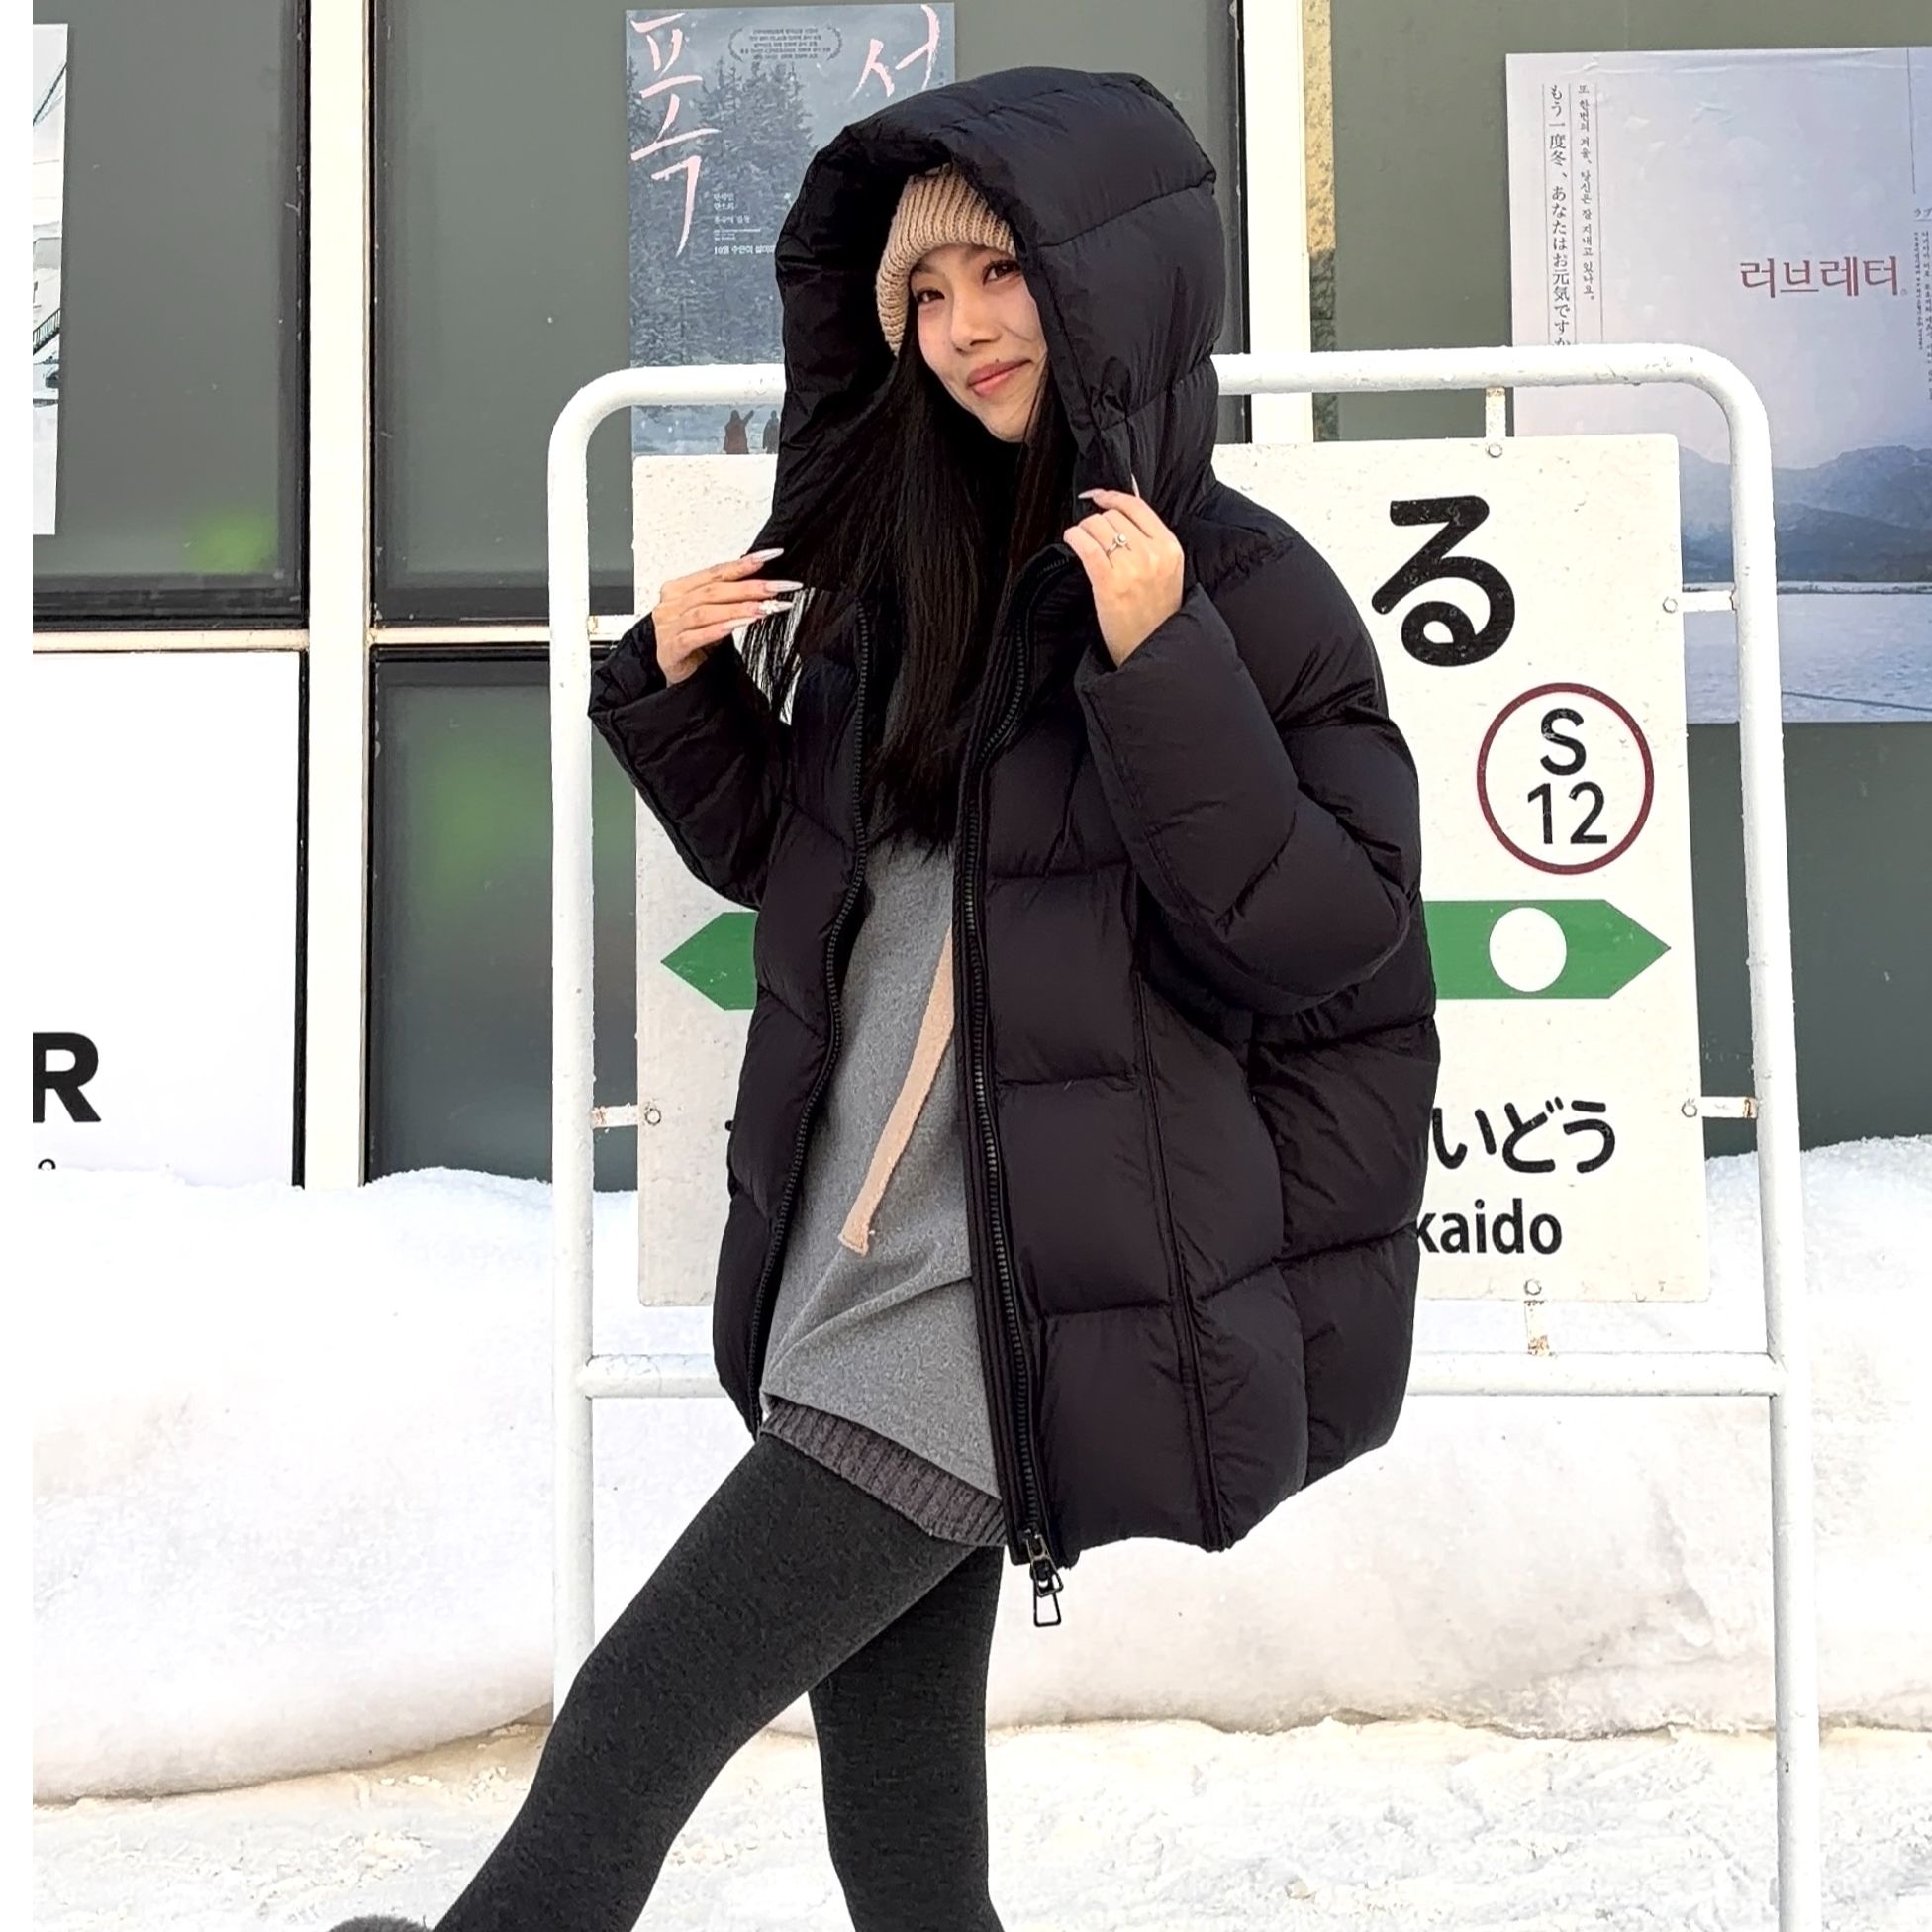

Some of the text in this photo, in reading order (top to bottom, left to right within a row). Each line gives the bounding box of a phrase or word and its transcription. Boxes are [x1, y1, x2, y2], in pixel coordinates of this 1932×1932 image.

[1739, 255, 1899, 299] 러브레터
[1371, 495, 1515, 667] る
[1539, 707, 1588, 777] S
[1527, 781, 1608, 845] 12
[32, 1031, 102, 1123] R
[1432, 1096, 1616, 1174] いどう
